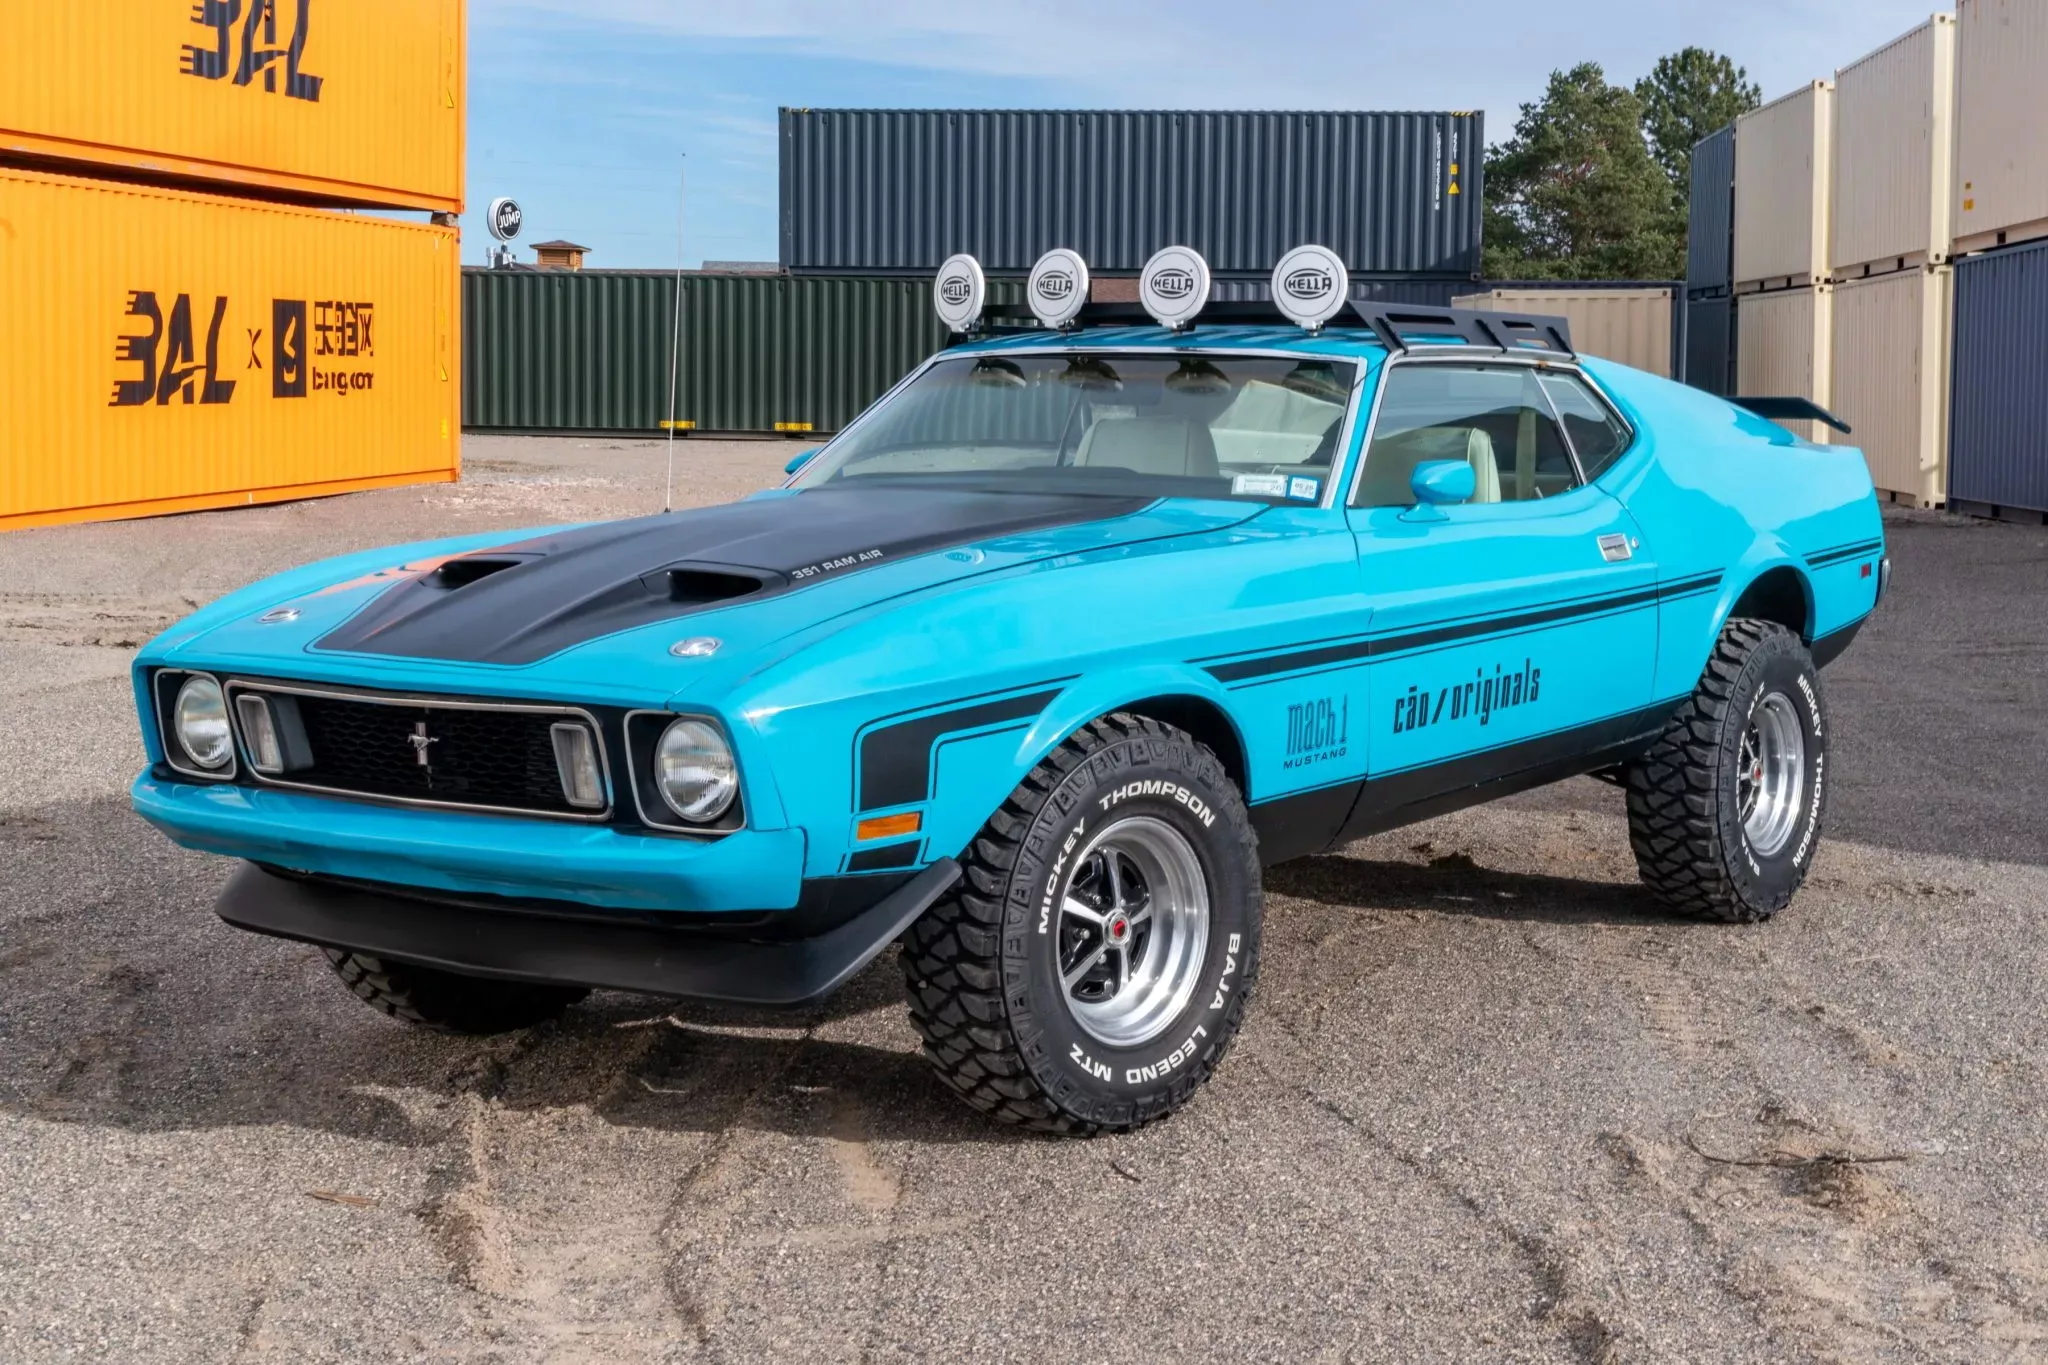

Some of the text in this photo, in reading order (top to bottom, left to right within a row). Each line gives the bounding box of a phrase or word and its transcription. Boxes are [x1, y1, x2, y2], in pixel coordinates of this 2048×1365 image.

[499, 210, 521, 229] JUMP
[943, 284, 971, 297] HELLA
[1039, 279, 1073, 293] HELLA
[1154, 278, 1194, 292] HELLA
[1288, 277, 1332, 291] HELLA
[791, 549, 884, 579] 351 RAM AIR
[1286, 697, 1336, 756] mach
[1283, 746, 1347, 770] MUSTANG
[1793, 673, 1823, 868] MICKEY THOMPSON
[1038, 780, 1216, 934] MICKEY THOMPSON
[1069, 932, 1241, 1084] BAJA LEGEND MTZ
